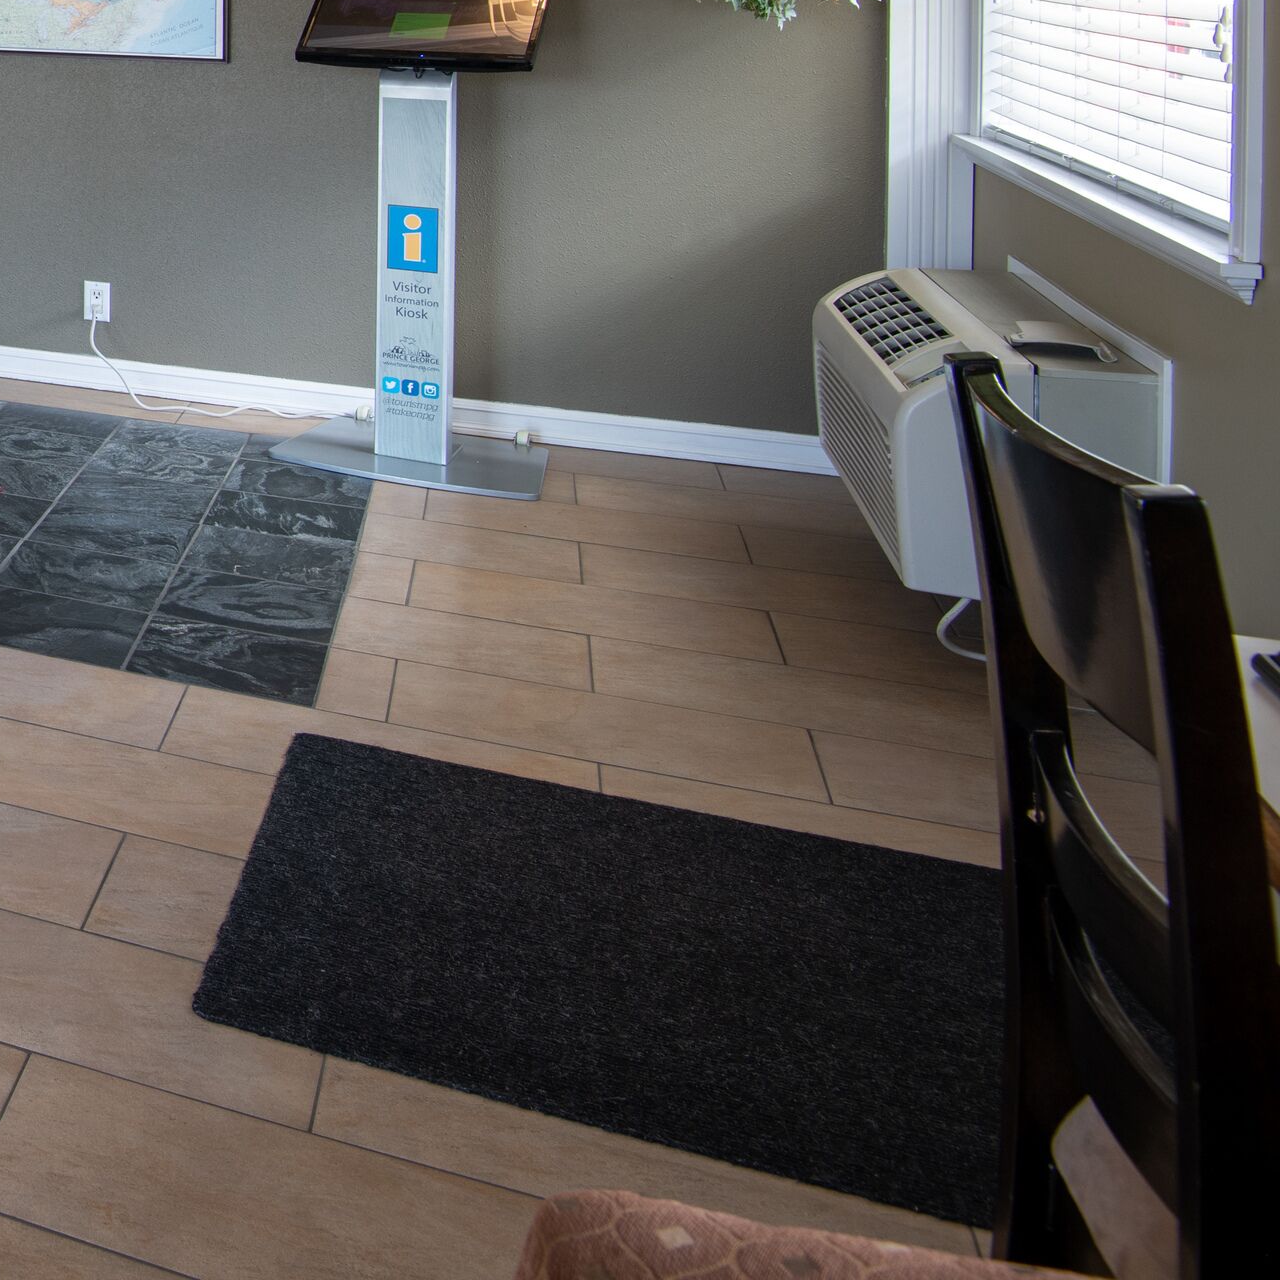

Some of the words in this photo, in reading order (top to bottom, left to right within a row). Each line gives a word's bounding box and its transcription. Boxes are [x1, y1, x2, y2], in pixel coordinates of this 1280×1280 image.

[393, 281, 431, 294] Visitor
[385, 295, 439, 307] Information
[396, 306, 428, 319] Kiosk
[383, 352, 407, 360] PRINCE
[410, 356, 440, 365] GEORGE
[383, 398, 438, 411] @tourismpg
[385, 408, 435, 421] #takeonpg
